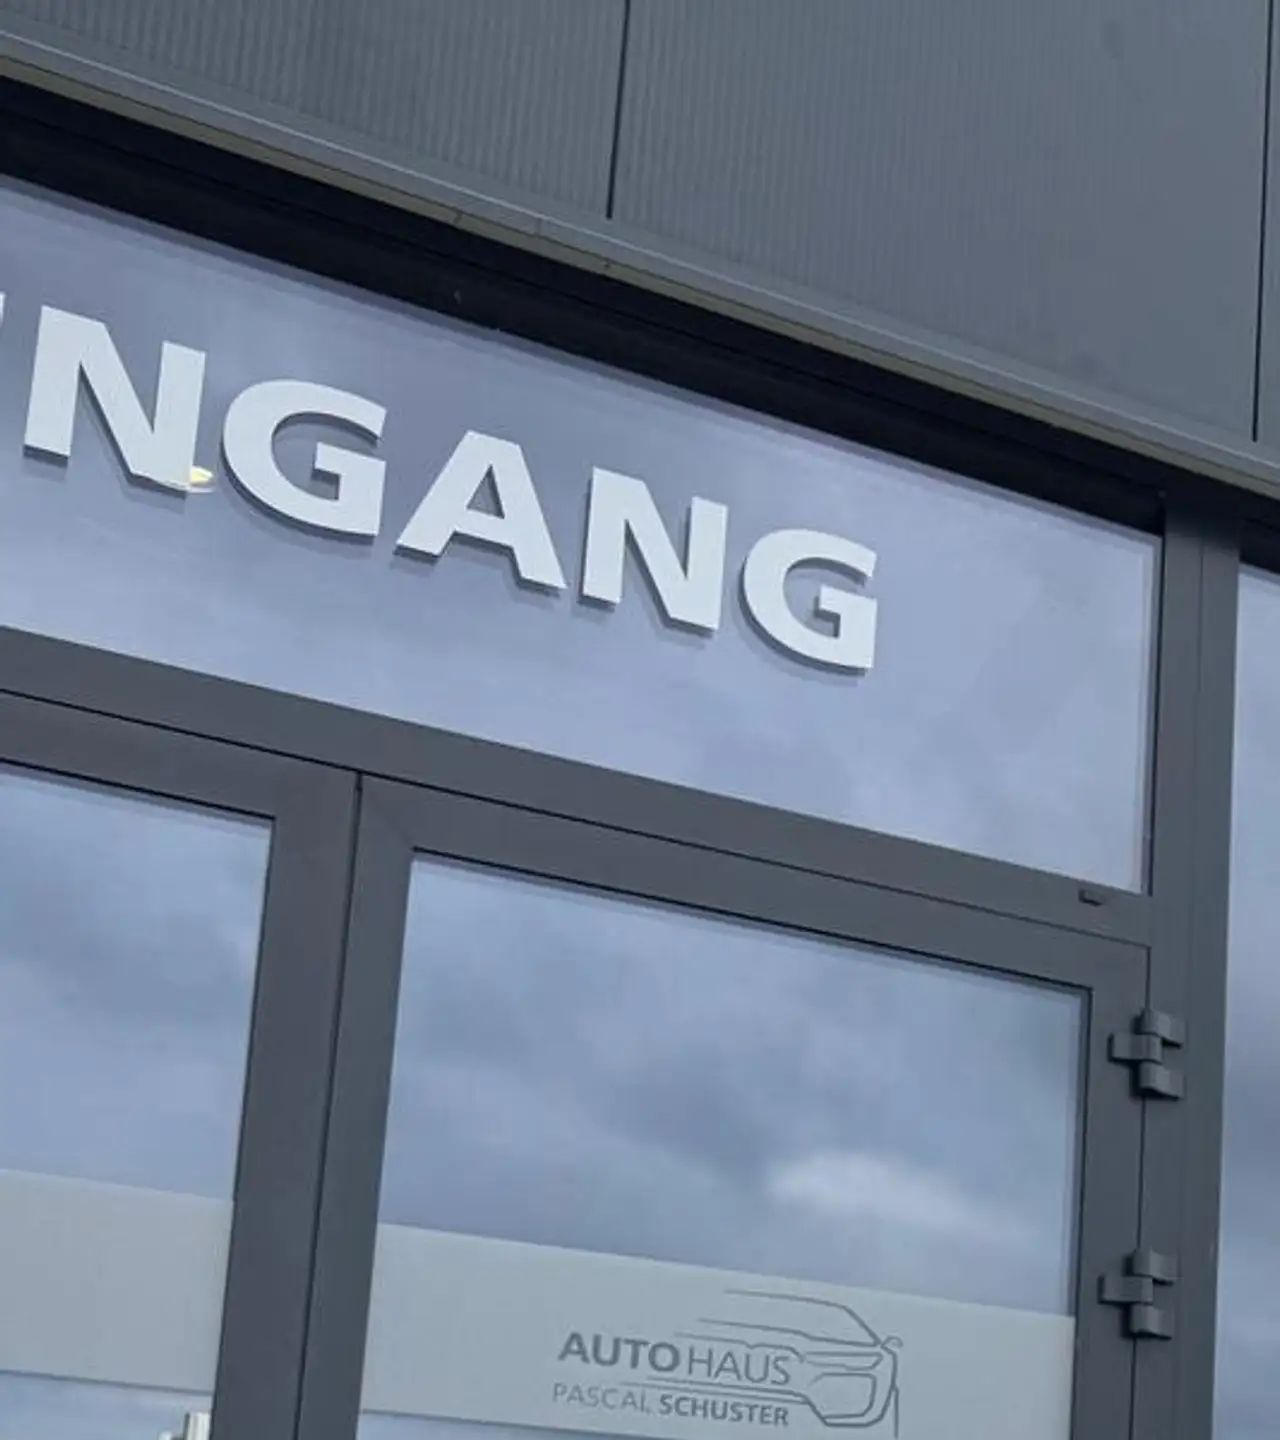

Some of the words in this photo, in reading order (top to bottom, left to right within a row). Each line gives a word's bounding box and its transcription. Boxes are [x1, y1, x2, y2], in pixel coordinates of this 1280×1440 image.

[0, 292, 878, 672] NGANG
[552, 1381, 651, 1414] PASCAL
[658, 1393, 790, 1427] SCHUSTER
